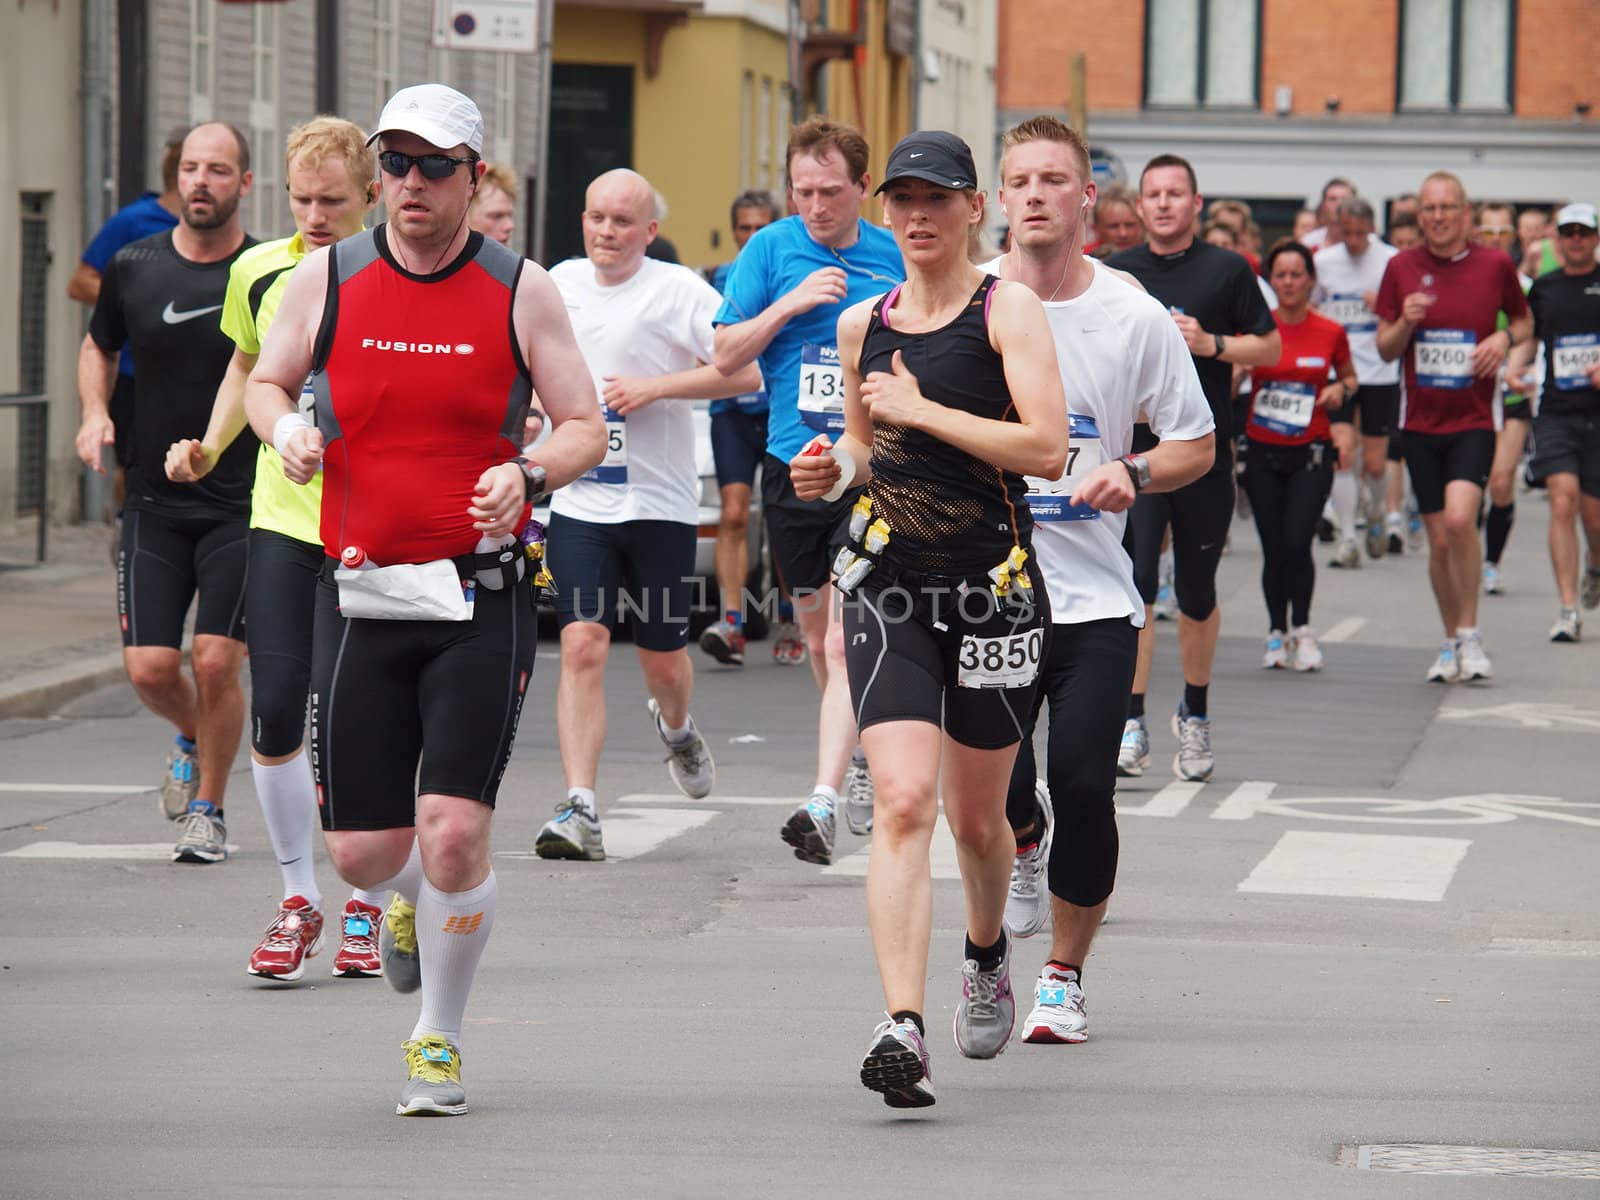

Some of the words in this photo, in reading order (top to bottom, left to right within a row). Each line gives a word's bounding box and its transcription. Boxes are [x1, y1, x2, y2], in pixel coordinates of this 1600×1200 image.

[361, 338, 451, 354] FUSION
[820, 346, 839, 359] Ny
[1419, 347, 1465, 365] 9260
[960, 632, 1042, 672] 3850
[311, 693, 321, 782] FUSION
